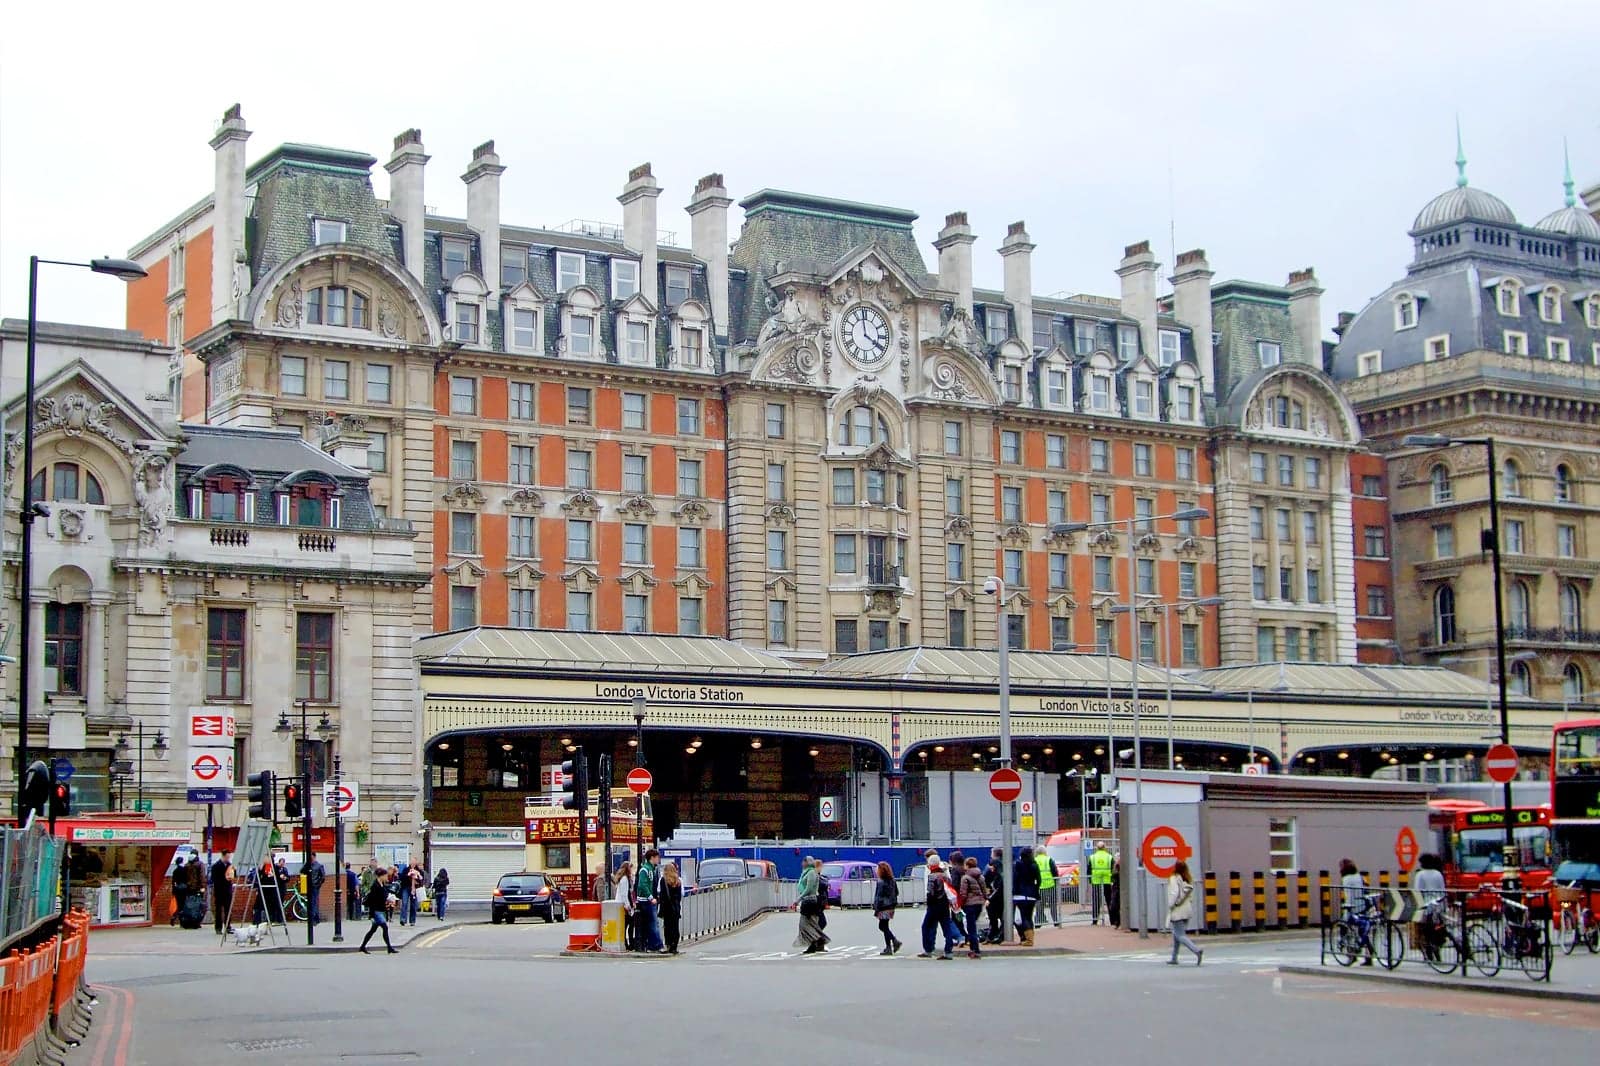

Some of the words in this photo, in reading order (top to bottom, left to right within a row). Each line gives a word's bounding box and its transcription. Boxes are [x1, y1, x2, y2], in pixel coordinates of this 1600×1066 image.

[595, 683, 644, 698] London
[647, 685, 696, 700] Victoria
[700, 687, 744, 701] Station
[1039, 698, 1078, 711] London
[1081, 699, 1121, 712] Victoia
[1124, 701, 1160, 714] Sttion
[1399, 709, 1431, 720] London
[1433, 710, 1465, 721] Victoria
[542, 822, 580, 833] BUS
[115, 829, 128, 838] Now
[129, 830, 145, 840] open
[1153, 848, 1175, 856] BUSES
